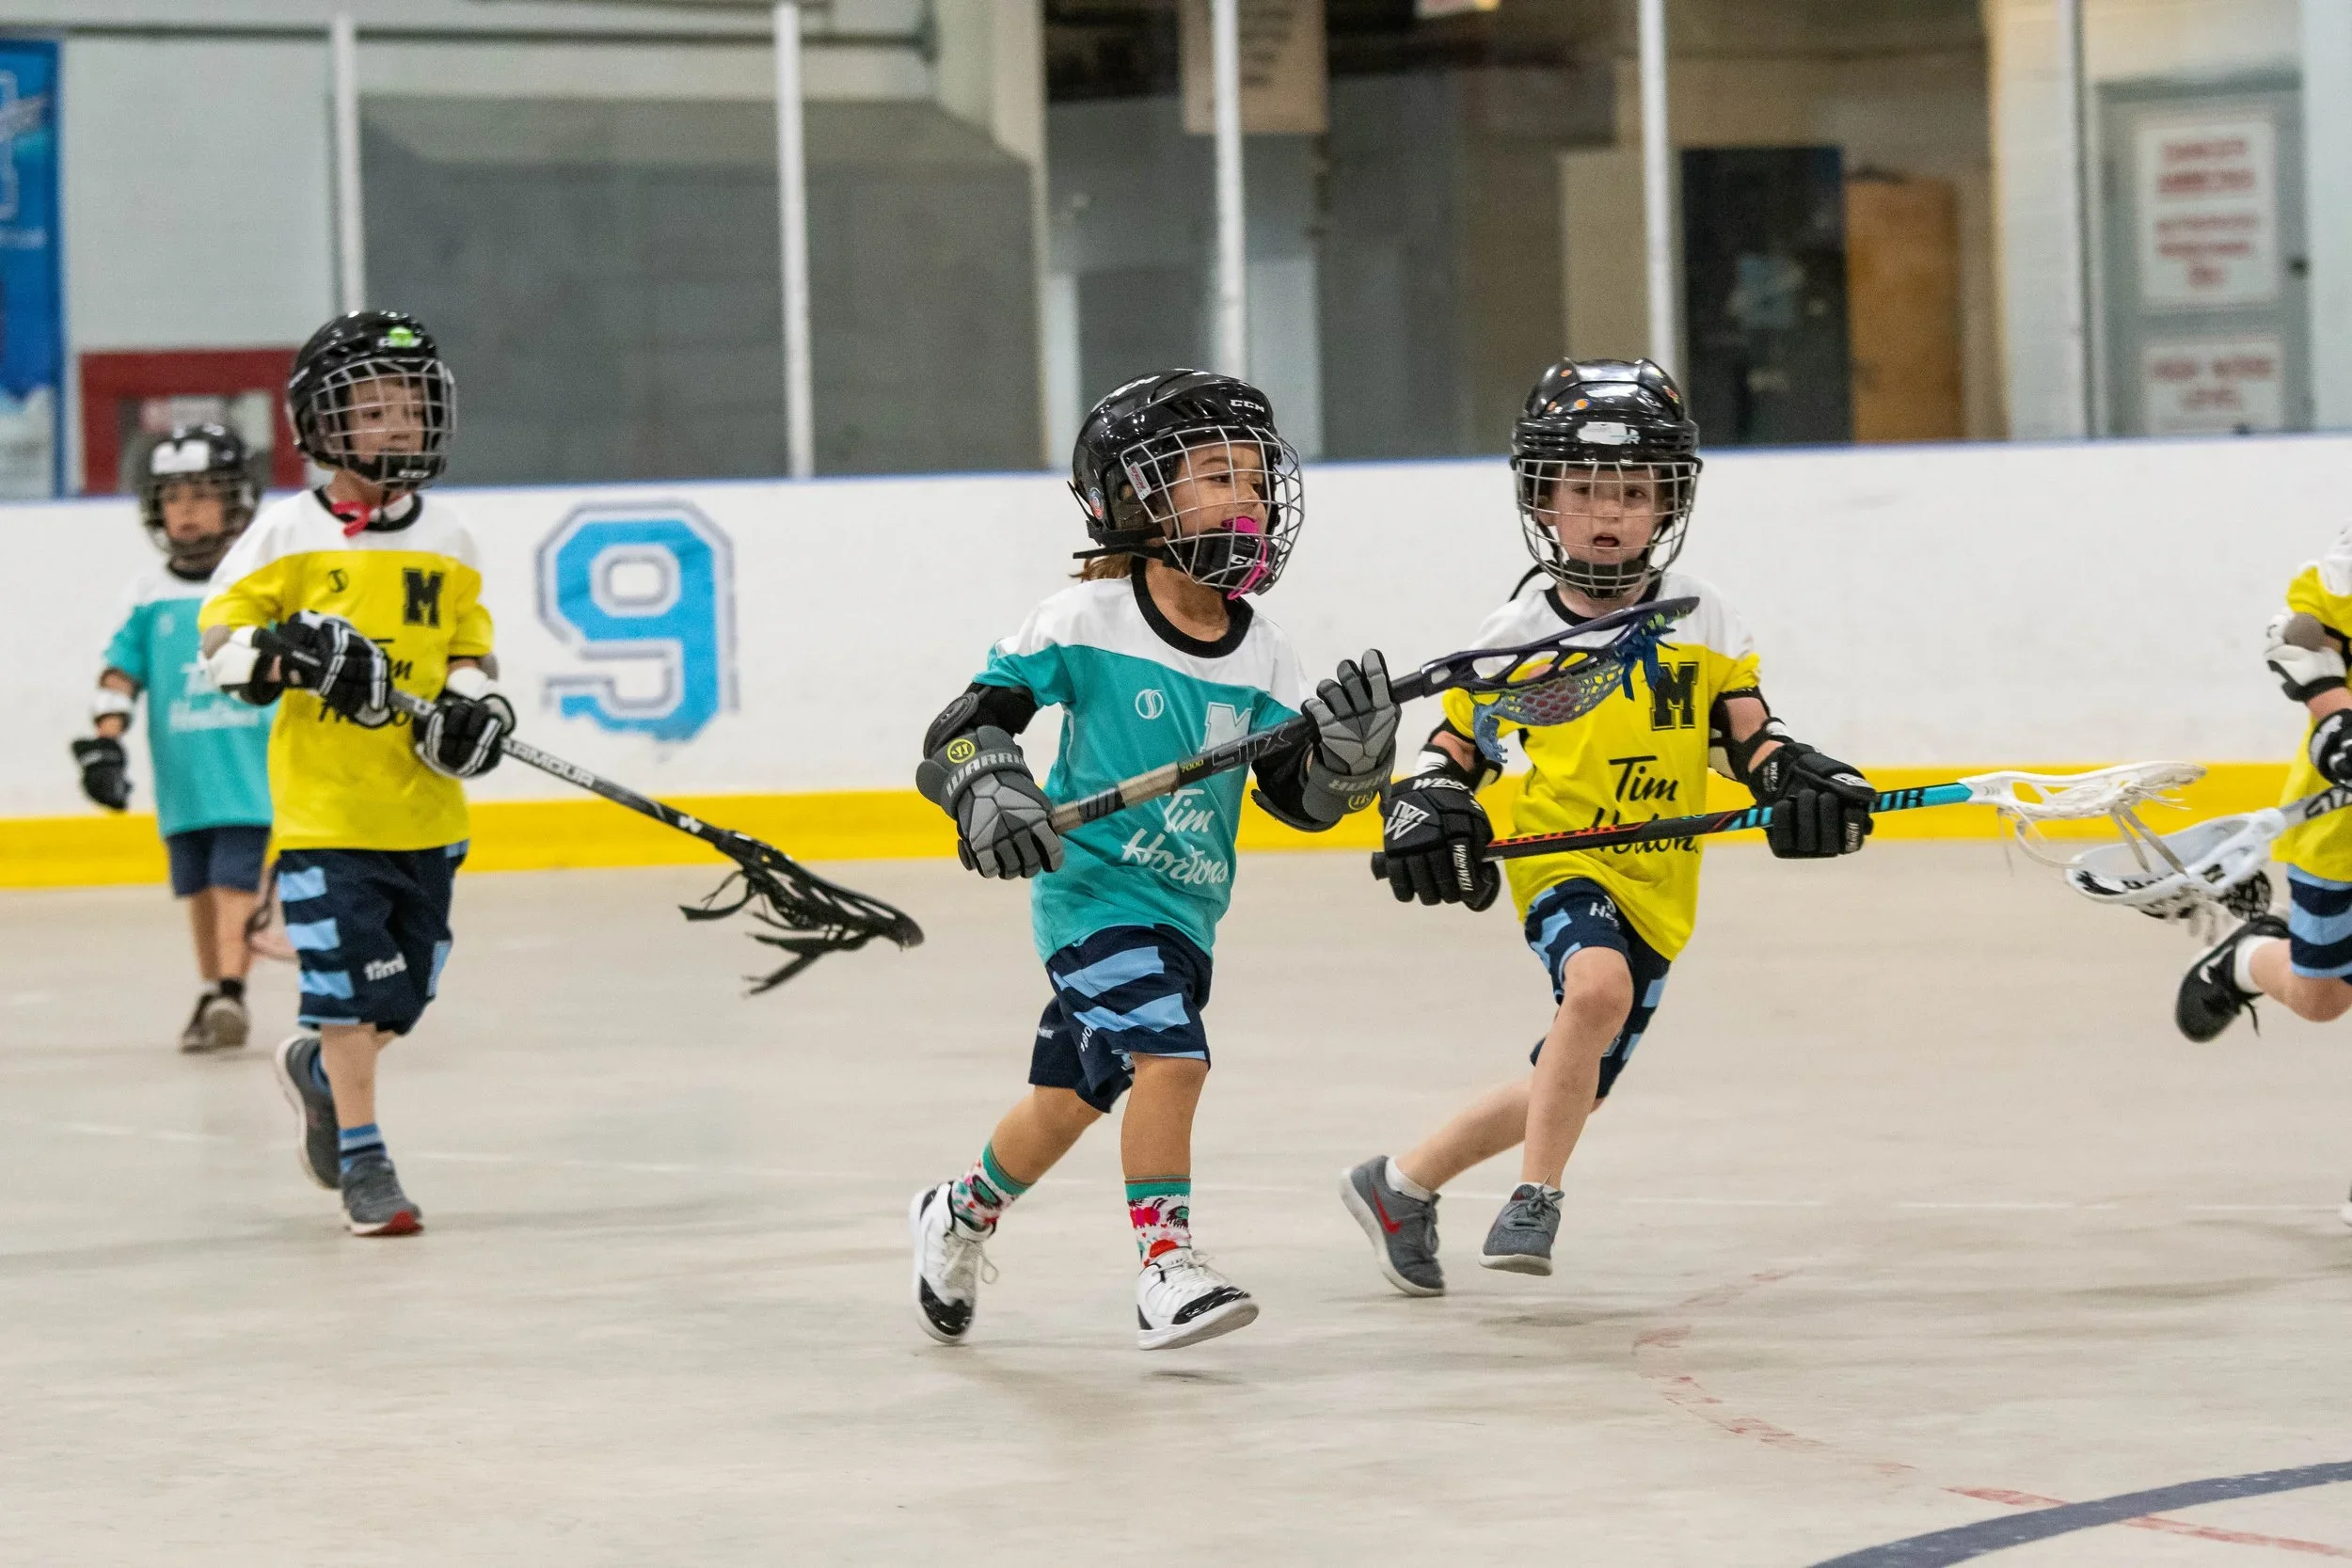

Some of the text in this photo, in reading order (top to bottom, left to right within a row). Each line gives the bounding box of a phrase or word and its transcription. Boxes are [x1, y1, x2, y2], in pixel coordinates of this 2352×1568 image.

[1230, 399, 1265, 413] CCM
[403, 567, 444, 629] M
[533, 499, 741, 744] 9
[1649, 661, 1699, 731] M
[1607, 754, 1679, 803] Tim
[1164, 788, 1216, 833] Tim
[1120, 827, 1230, 886] Hortons
